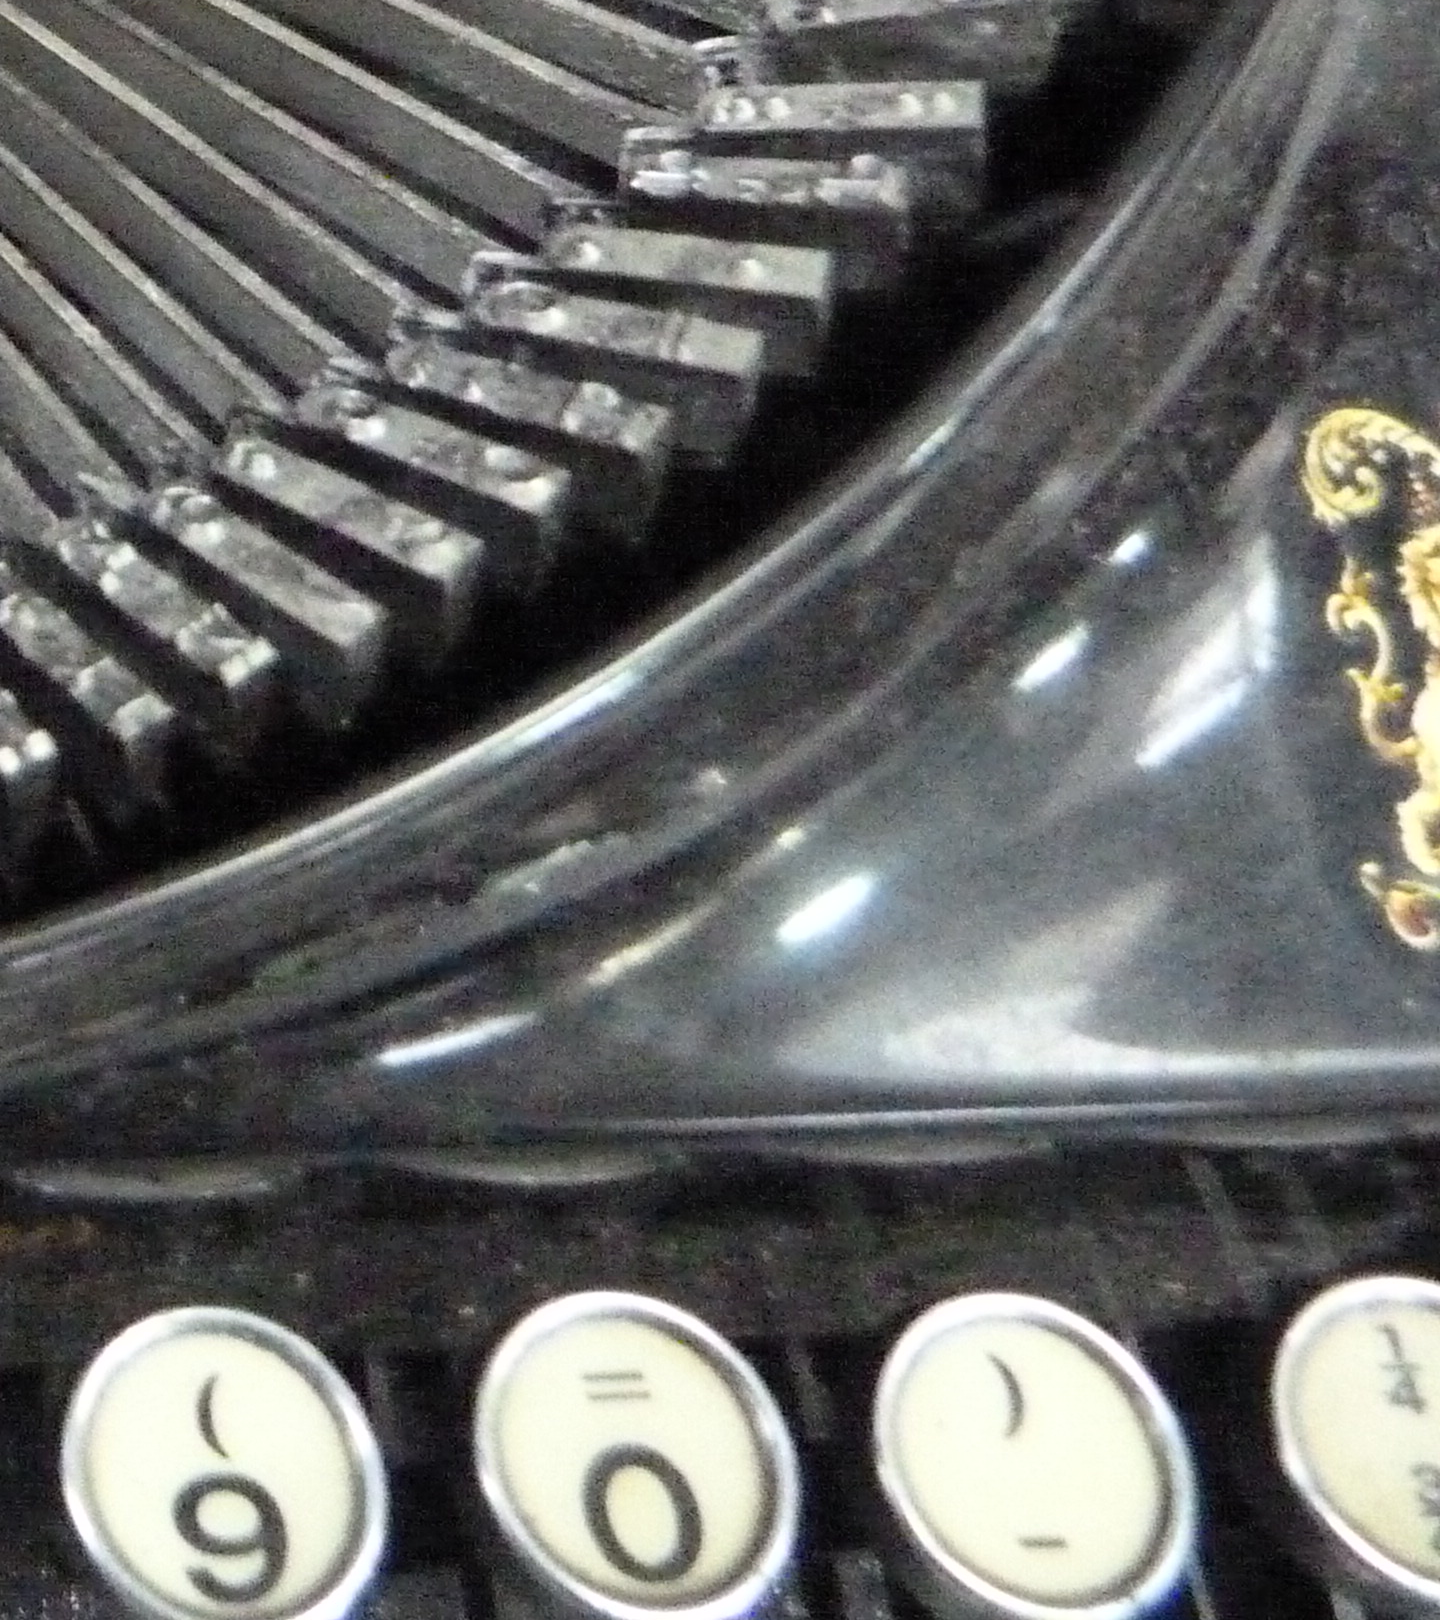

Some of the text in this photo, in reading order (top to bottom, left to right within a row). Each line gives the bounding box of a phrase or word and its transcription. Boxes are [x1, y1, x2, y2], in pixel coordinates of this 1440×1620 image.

[198, 1374, 229, 1459] (
[581, 1369, 653, 1404] =
[988, 1354, 1025, 1439] )
[172, 1473, 288, 1603] 9
[580, 1444, 700, 1583] 0
